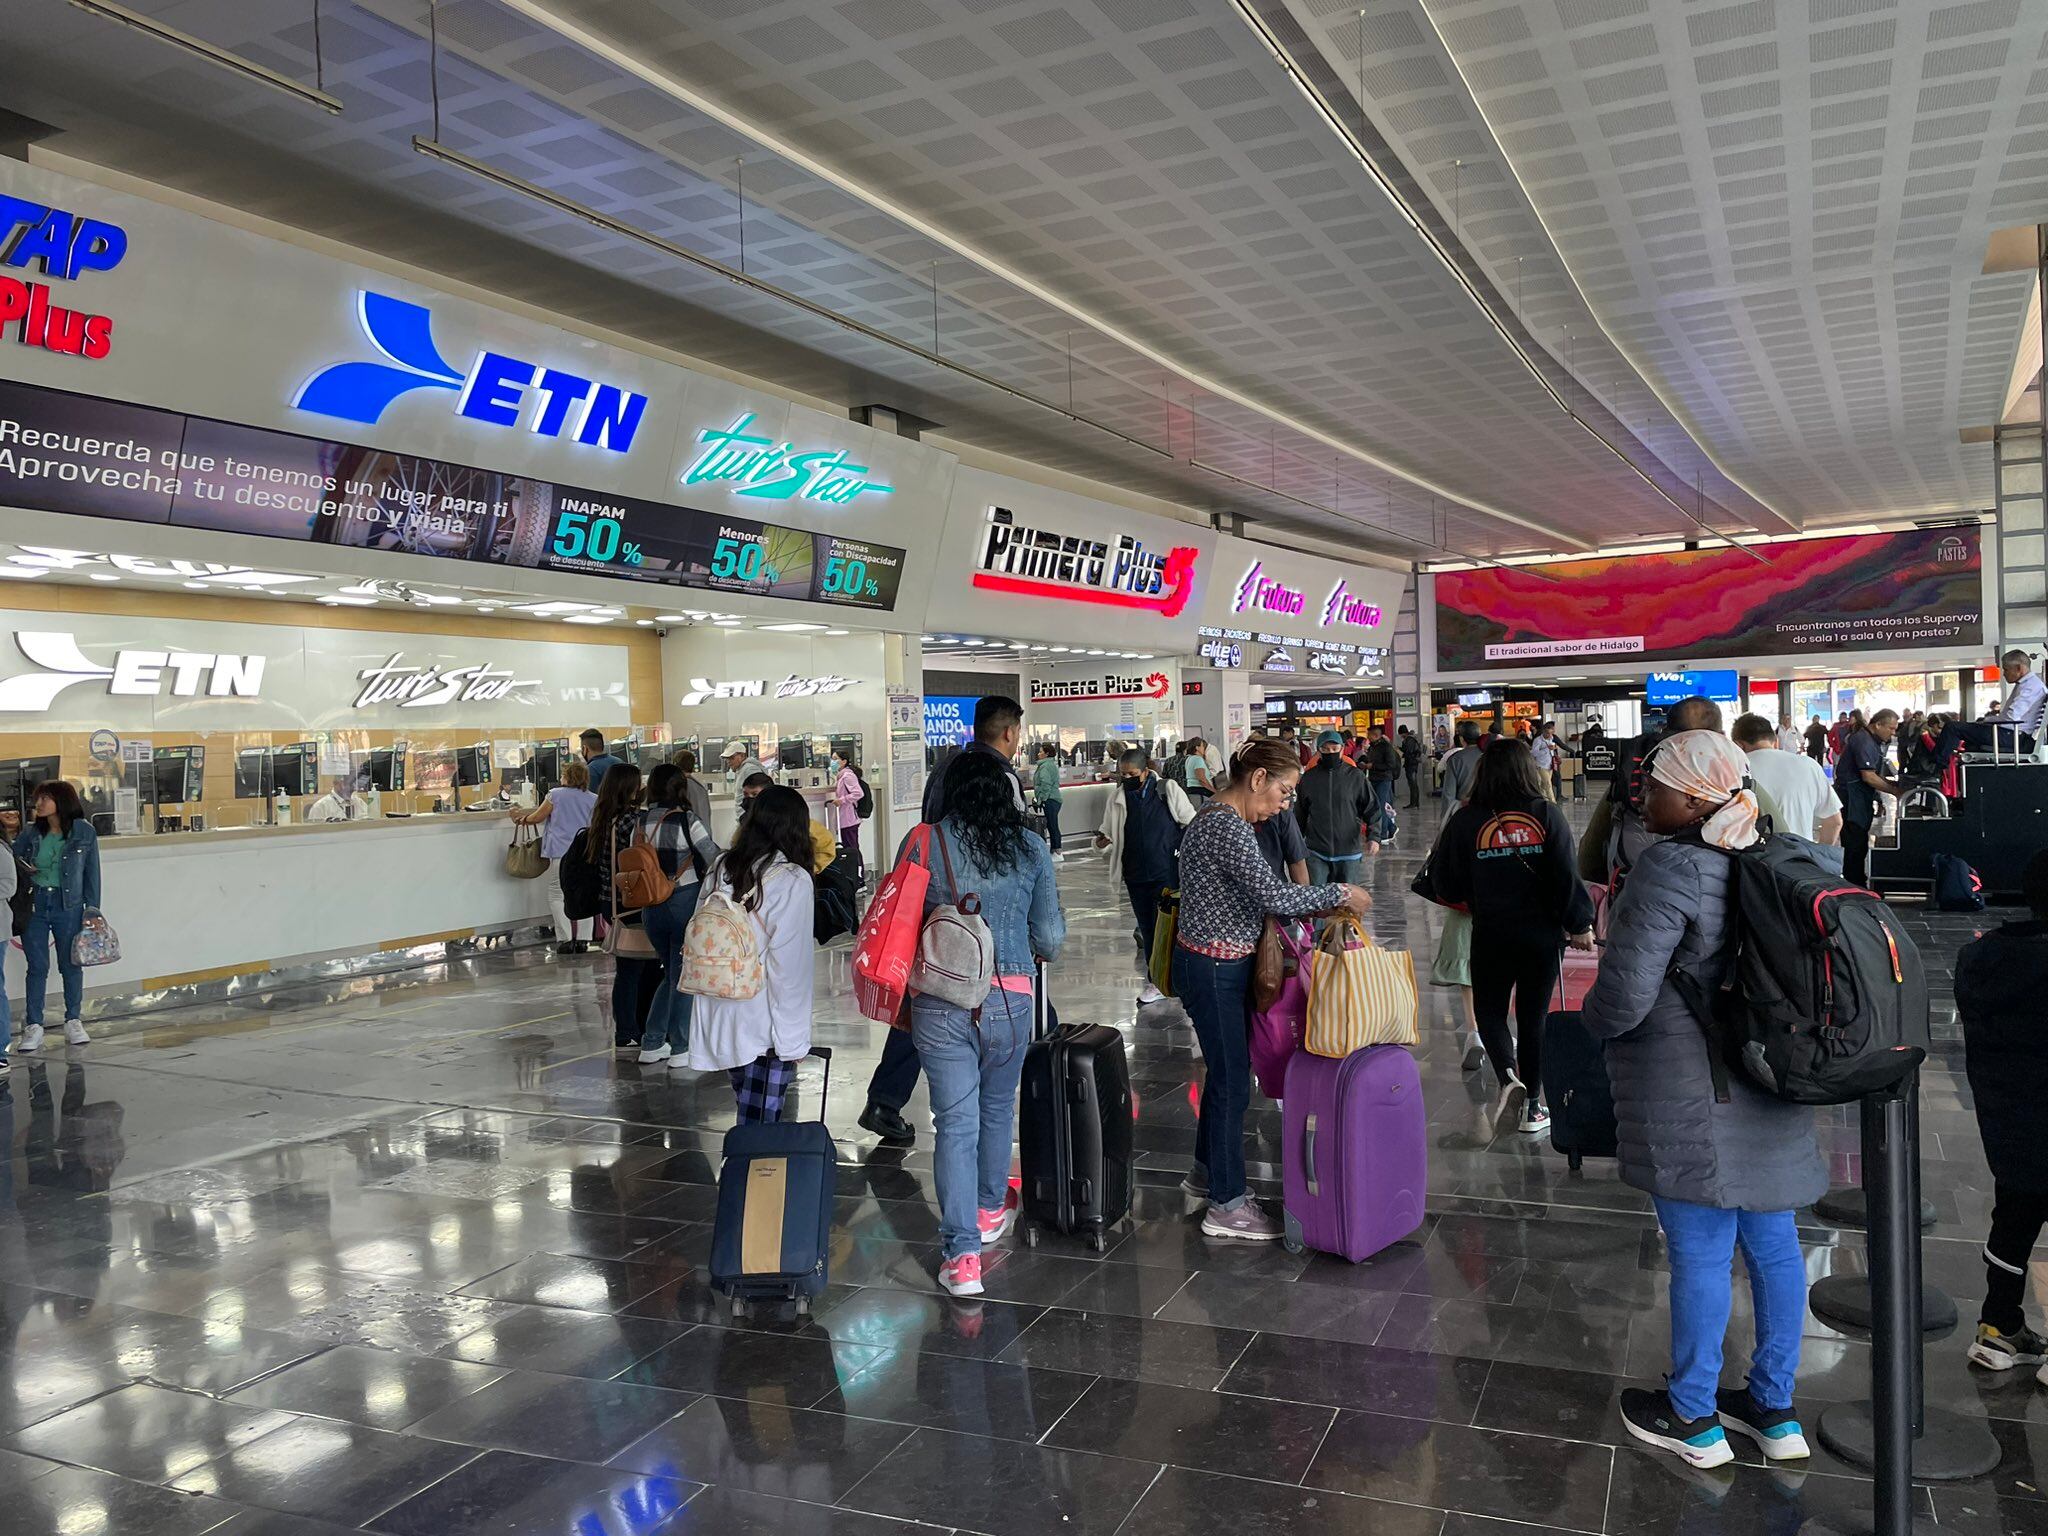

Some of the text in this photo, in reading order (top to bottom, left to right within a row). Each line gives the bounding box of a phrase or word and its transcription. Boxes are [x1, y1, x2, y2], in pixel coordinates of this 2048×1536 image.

[0, 194, 128, 281] TAP
[0, 275, 113, 360] Plus
[454, 350, 648, 453] ETN
[0, 420, 508, 517] Recuerda que tenemos un lugar para ti
[0, 449, 465, 534] Aprovecha tu descuento y viaja
[560, 498, 626, 520] INAPAM
[718, 526, 770, 544] Menores
[831, 539, 869, 553] Personas
[977, 505, 1109, 587] Primera
[1937, 546, 1967, 562] PASTES
[550, 555, 605, 568] de descuento
[829, 549, 897, 567] con Discapacidad
[1251, 575, 1305, 616] Futura
[1337, 594, 1383, 628] Futura
[1853, 620, 1868, 628] en
[1870, 618, 1902, 627] todos
[1904, 616, 1921, 624] los
[1923, 613, 1979, 625] Supervoy
[1793, 635, 1807, 644] de
[1809, 634, 1832, 642] sala
[1850, 632, 1874, 640] sala
[1876, 631, 1883, 639] 6
[1886, 631, 1893, 640] y
[1895, 630, 1910, 638] en
[1953, 627, 1960, 635] 7
[1201, 640, 1231, 659] elite
[1489, 640, 1640, 656] El tradicional sabor de Hidalgo
[107, 650, 266, 696] ETN
[714, 680, 767, 698] ETN
[1031, 675, 1143, 698] Primera Plus
[923, 718, 964, 734] ANDO
